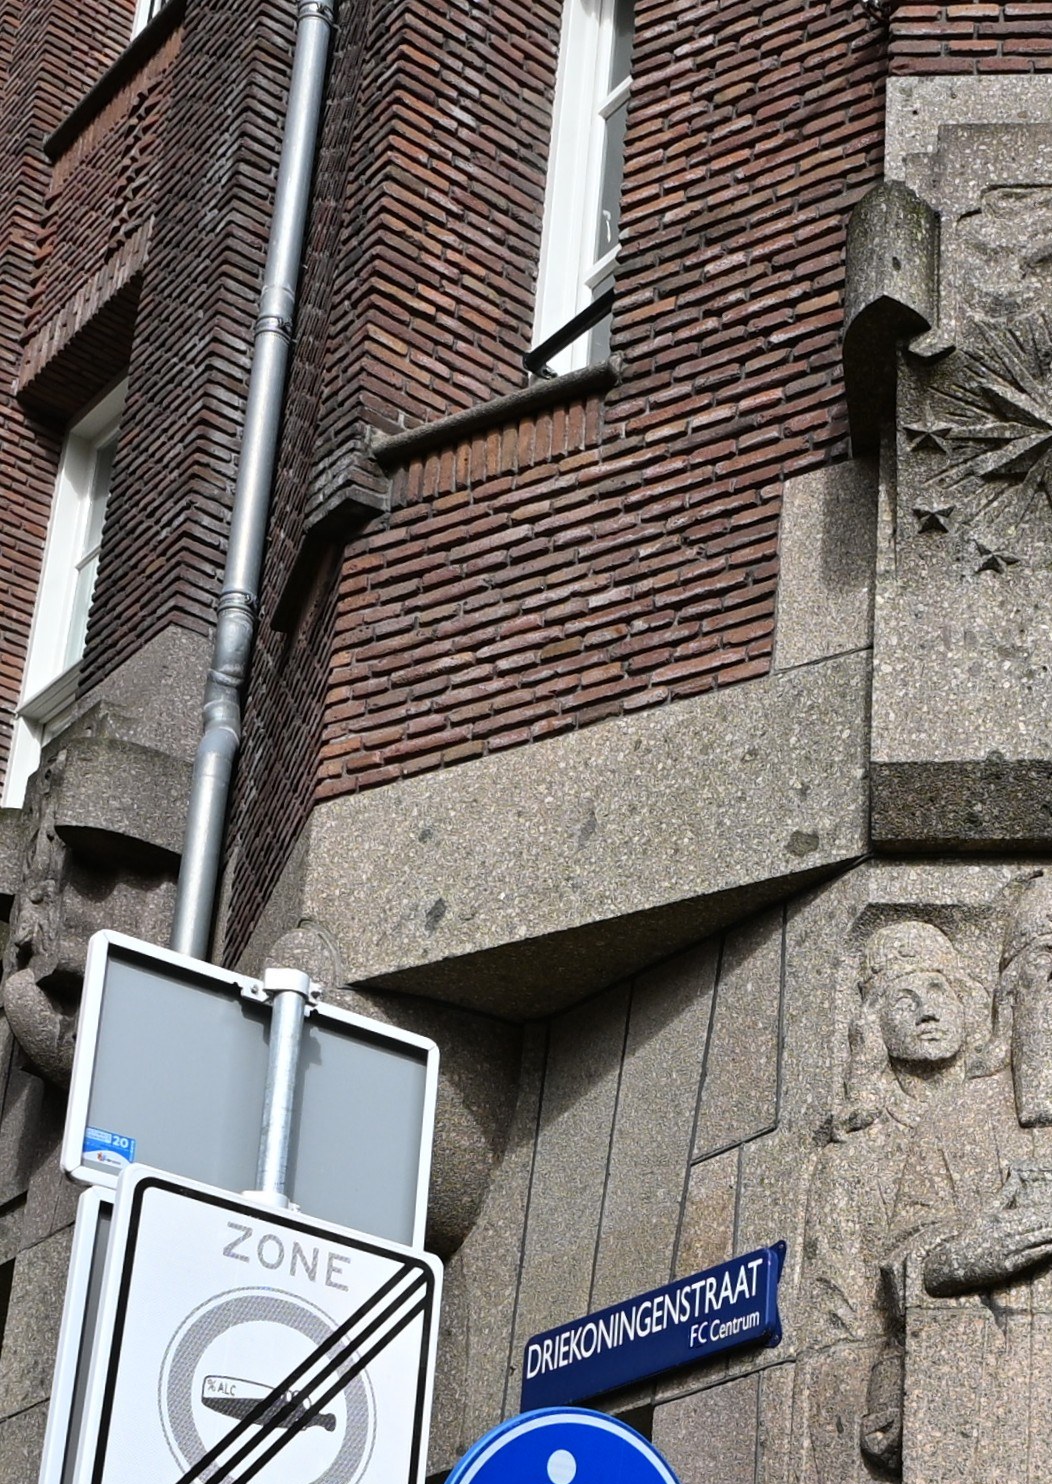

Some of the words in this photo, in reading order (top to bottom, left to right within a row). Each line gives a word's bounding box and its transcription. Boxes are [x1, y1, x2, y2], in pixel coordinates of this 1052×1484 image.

[113, 1136, 128, 1148] 20
[223, 1221, 351, 1292] ZONE
[526, 1258, 763, 1379] DRIEKONINGENSTRAAT
[709, 1311, 760, 1342] Centrum
